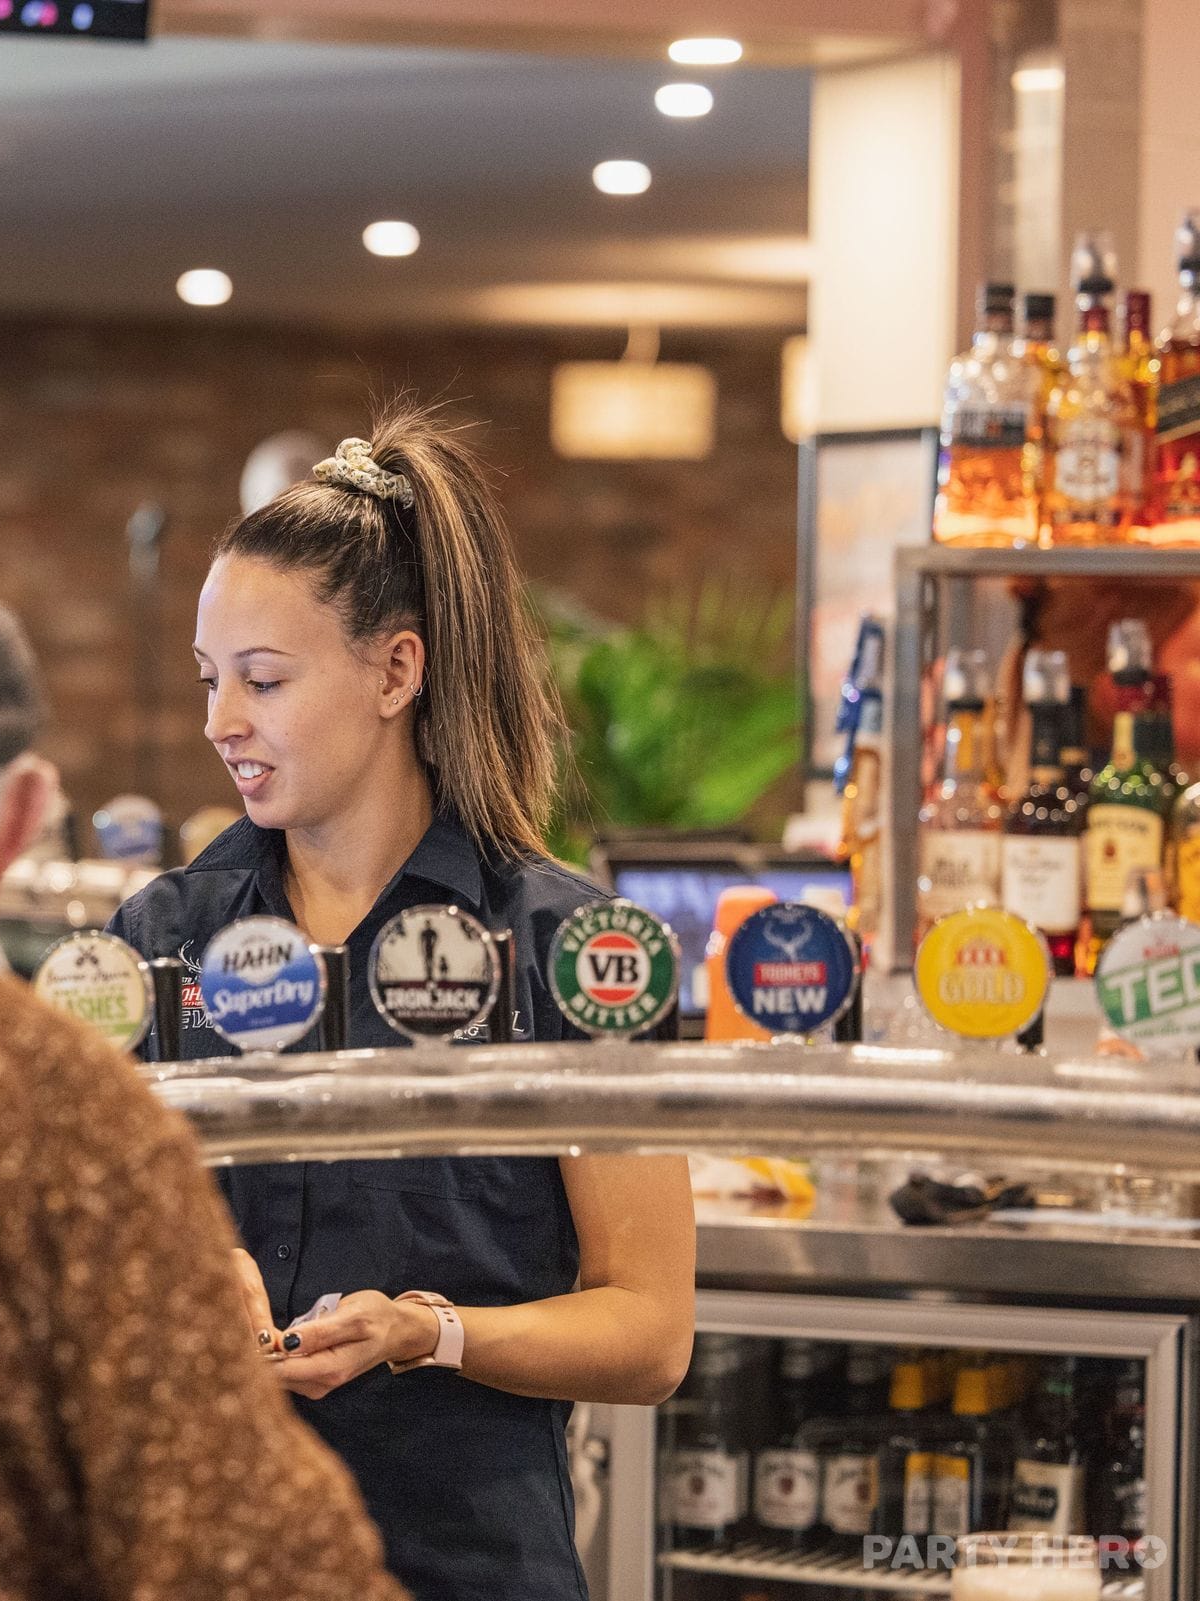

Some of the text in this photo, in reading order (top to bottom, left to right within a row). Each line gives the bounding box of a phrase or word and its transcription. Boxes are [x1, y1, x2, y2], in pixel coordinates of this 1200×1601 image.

[562, 910, 662, 957] VICTORIA
[223, 943, 292, 974] HAHN
[588, 954, 639, 983] VB
[213, 979, 314, 1020] SuperDry
[752, 987, 828, 1014] NEW
[939, 972, 1025, 1005] GOLD
[569, 992, 659, 1026] BITTER
